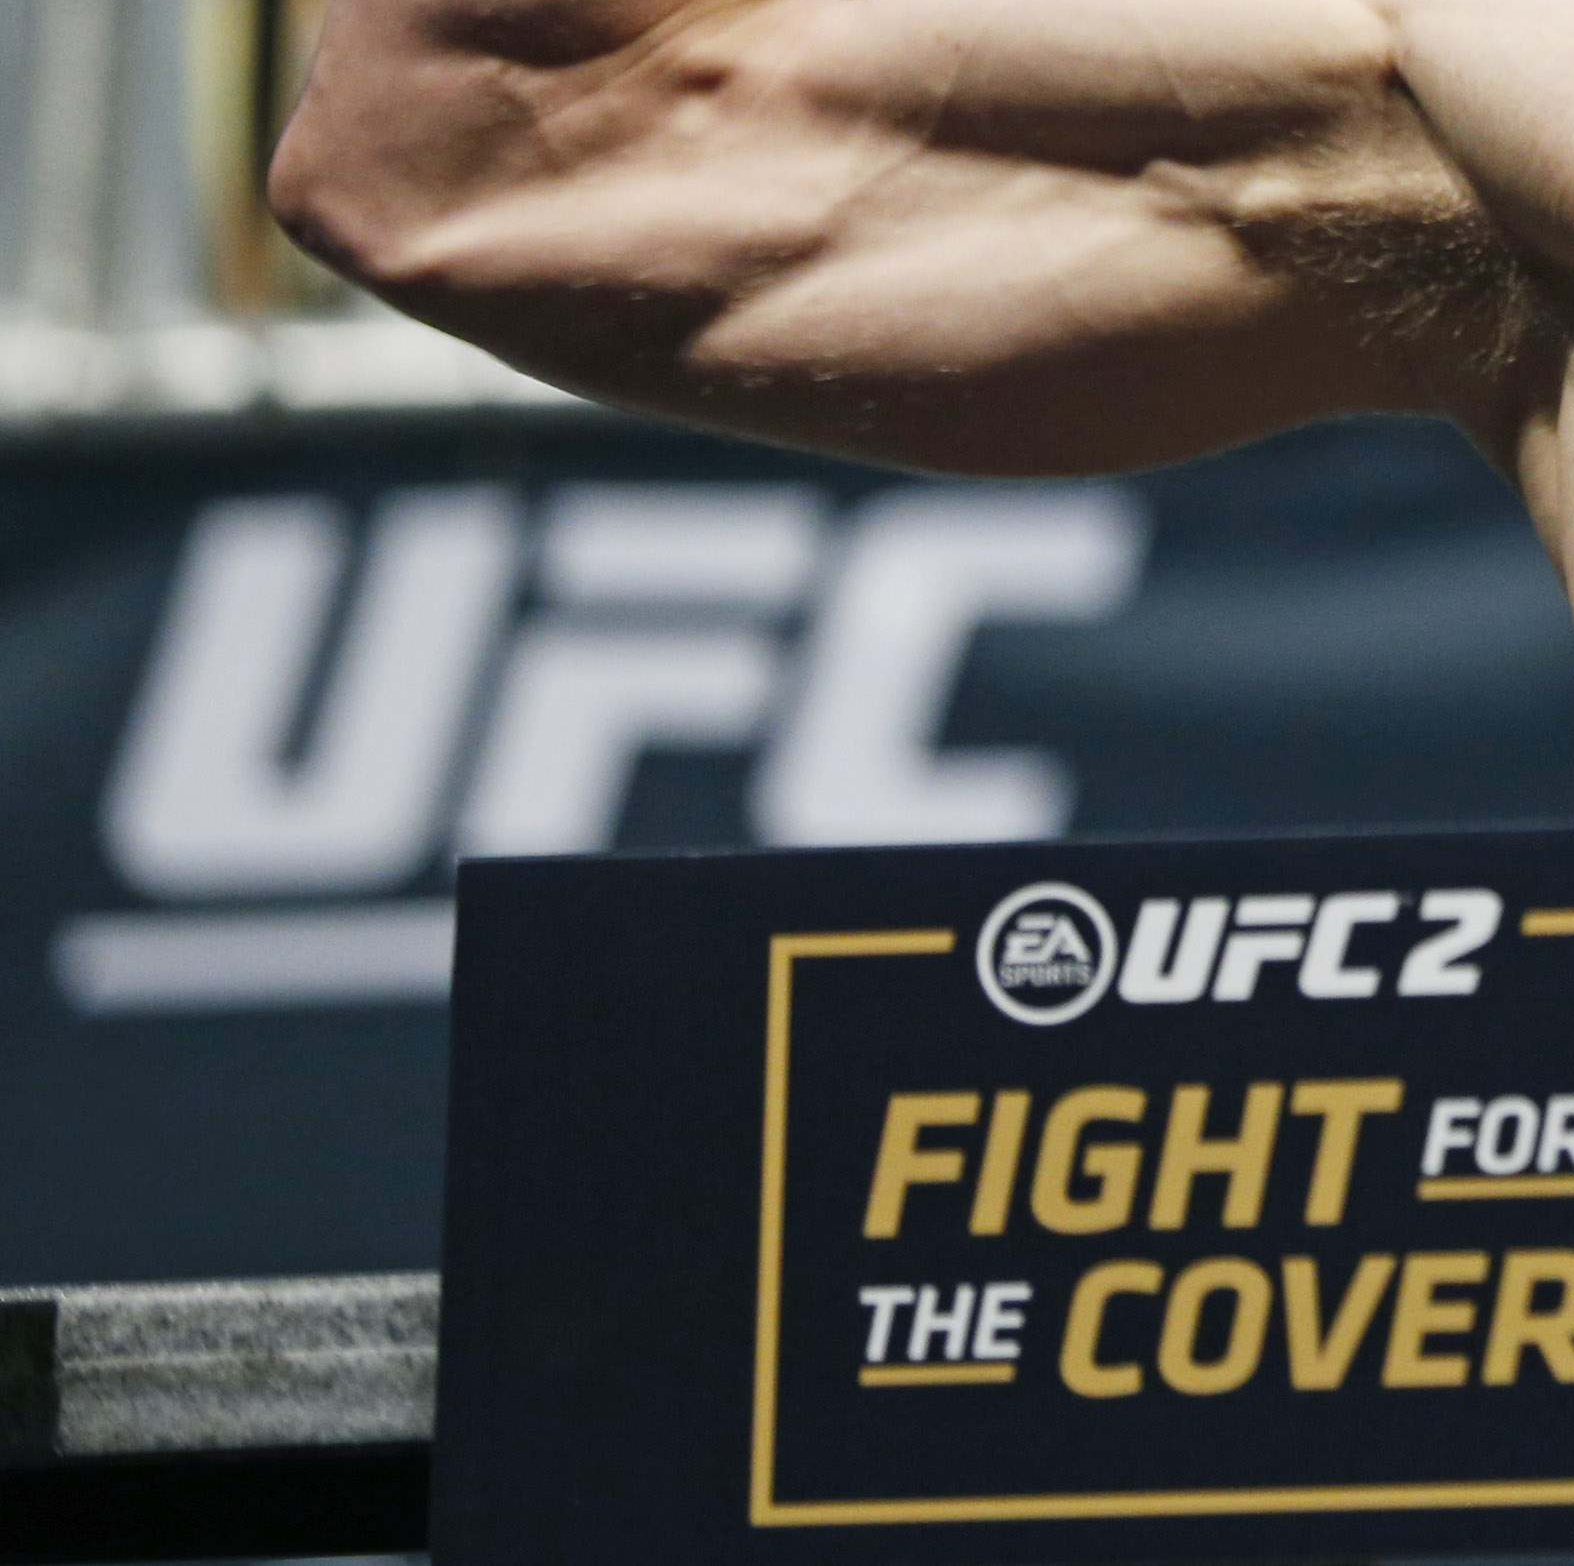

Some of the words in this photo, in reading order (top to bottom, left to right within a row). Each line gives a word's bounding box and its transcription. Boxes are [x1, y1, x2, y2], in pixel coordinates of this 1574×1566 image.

[105, 482, 1145, 899] UFC
[1000, 963, 1094, 989] SPORTS
[1003, 913, 1093, 964] EA
[1118, 892, 1400, 1005] UFC
[1398, 887, 1503, 998] 2
[862, 1079, 1403, 1239] FIGHT
[858, 1283, 1032, 1363] THE
